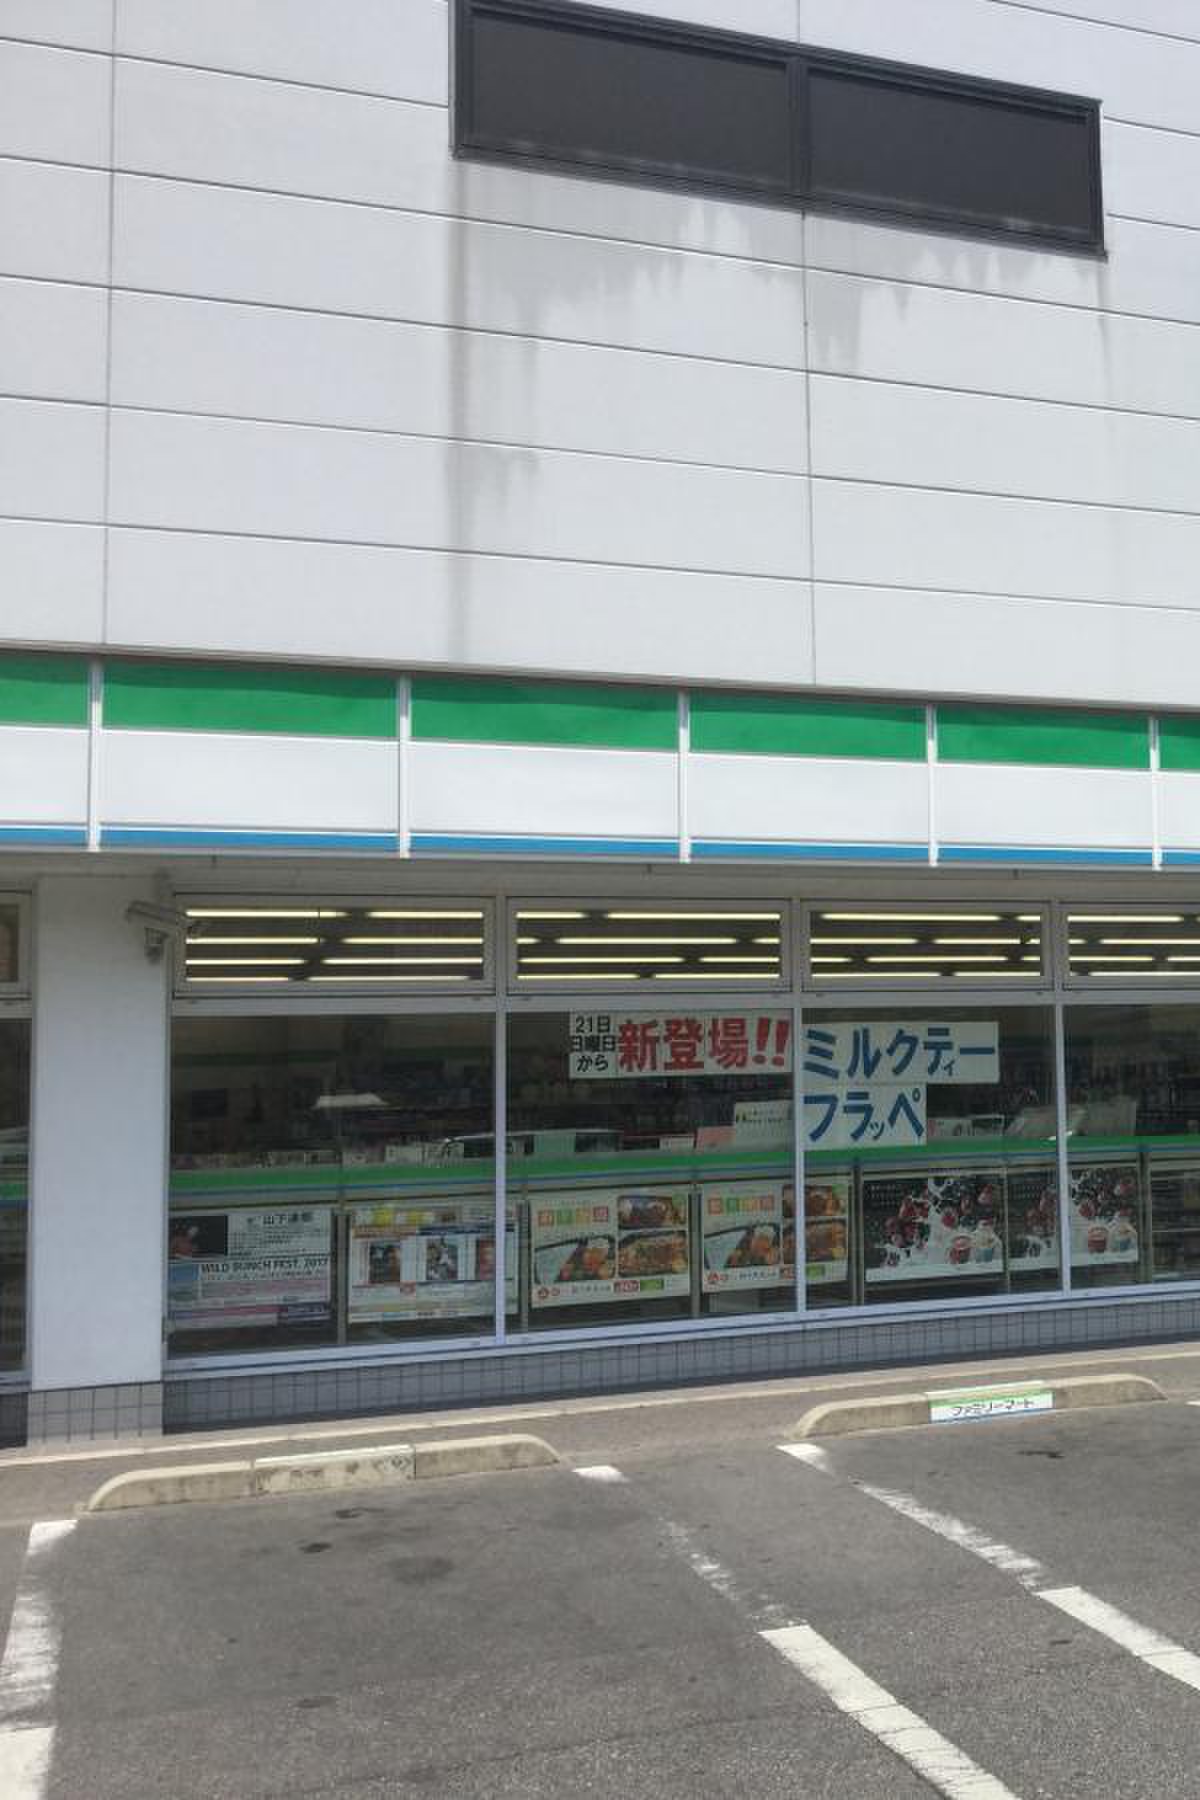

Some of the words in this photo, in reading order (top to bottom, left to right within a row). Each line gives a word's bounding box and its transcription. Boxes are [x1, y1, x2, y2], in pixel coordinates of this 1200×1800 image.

[575, 1015, 611, 1034] 21日
[571, 1034, 617, 1052] 日曜日
[802, 1027, 996, 1079] ミルクティー
[576, 1055, 610, 1073] から
[802, 1086, 926, 1142] フラッペ
